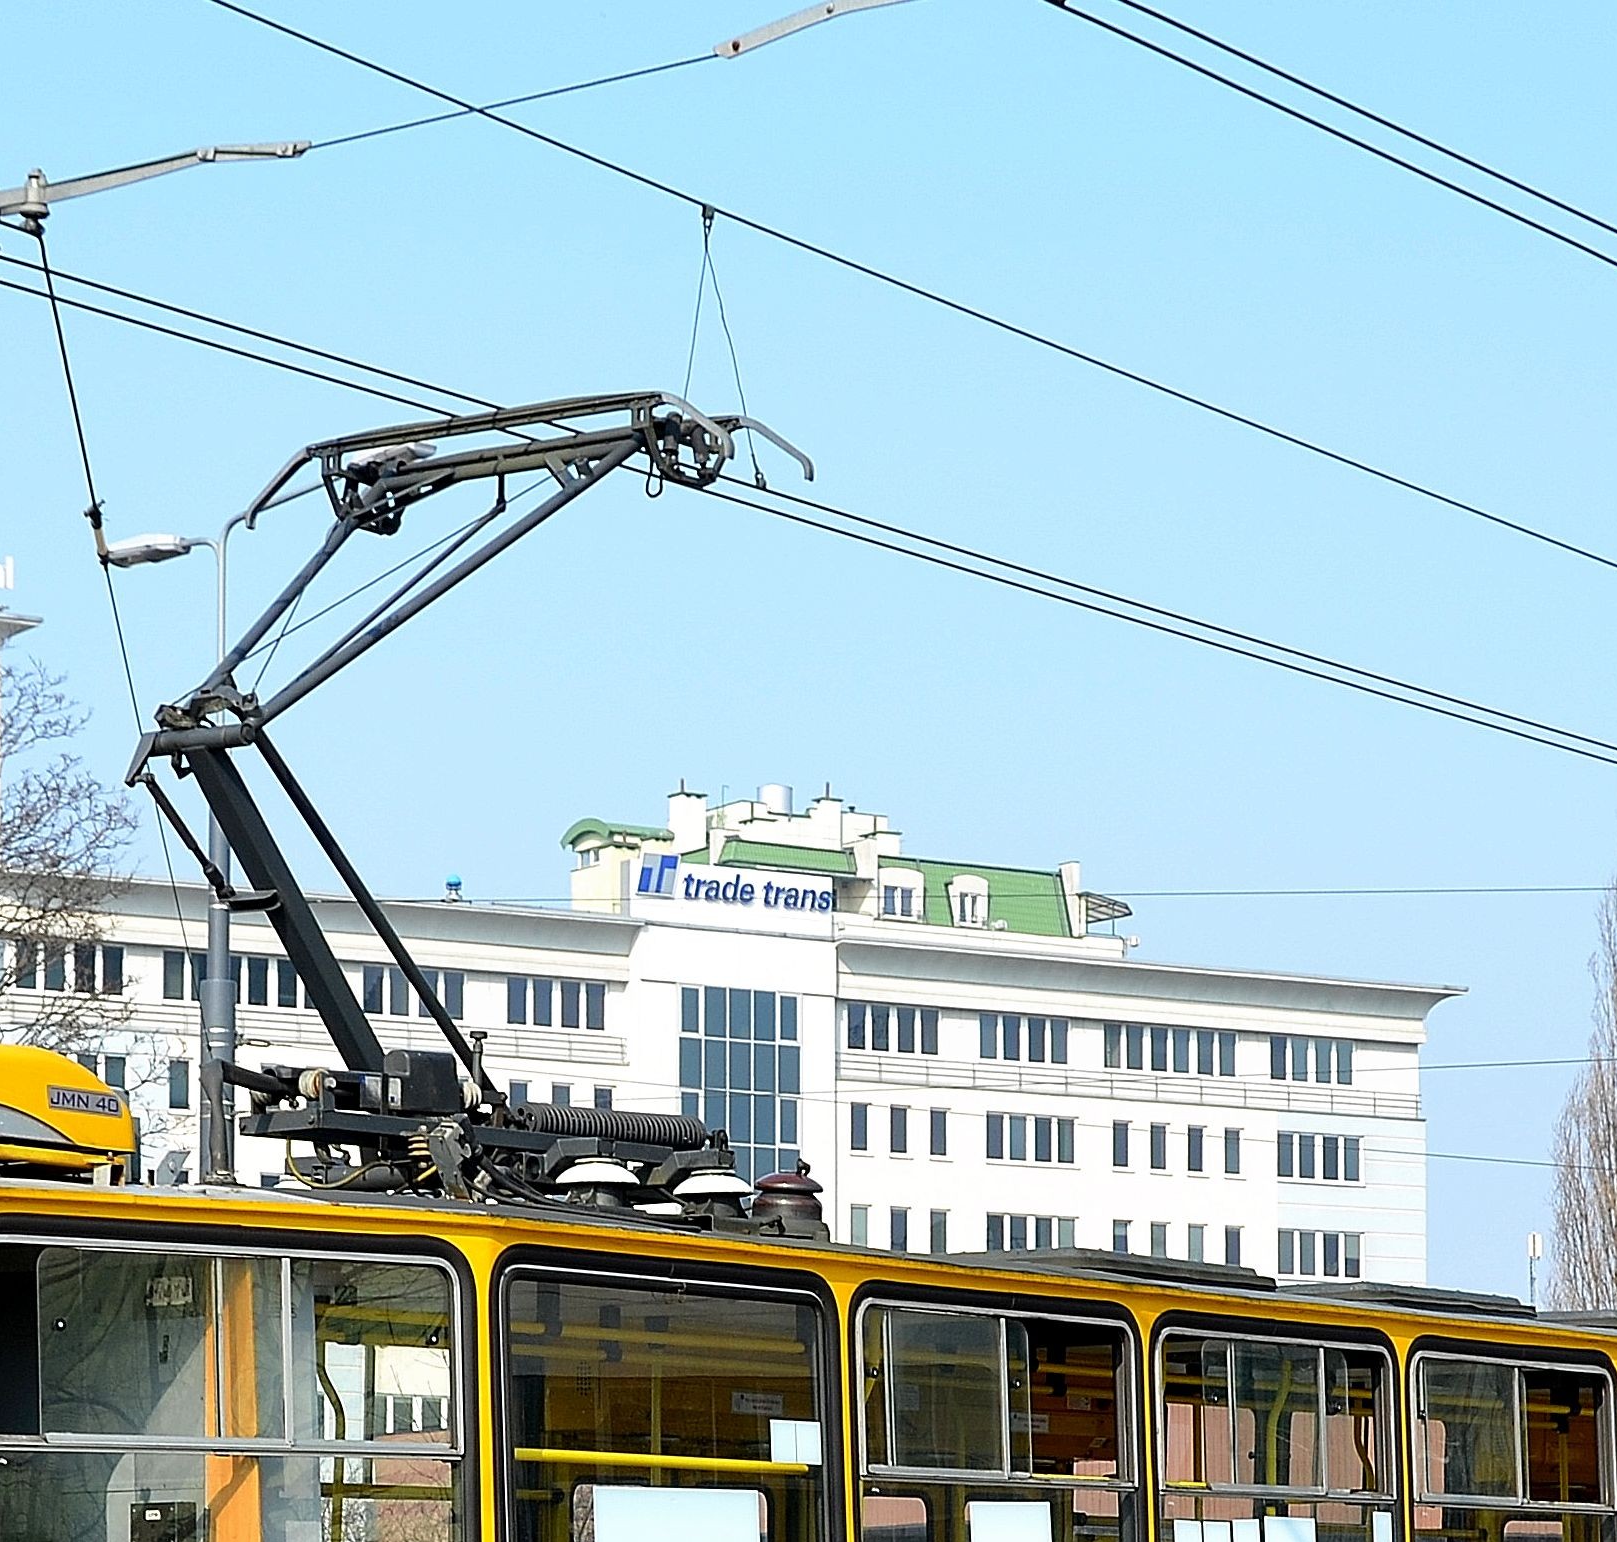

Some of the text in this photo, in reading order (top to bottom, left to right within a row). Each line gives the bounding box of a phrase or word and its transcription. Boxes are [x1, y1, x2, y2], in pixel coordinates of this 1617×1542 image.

[683, 873, 832, 911] trade trans
[50, 1091, 119, 1112] JMN 40
